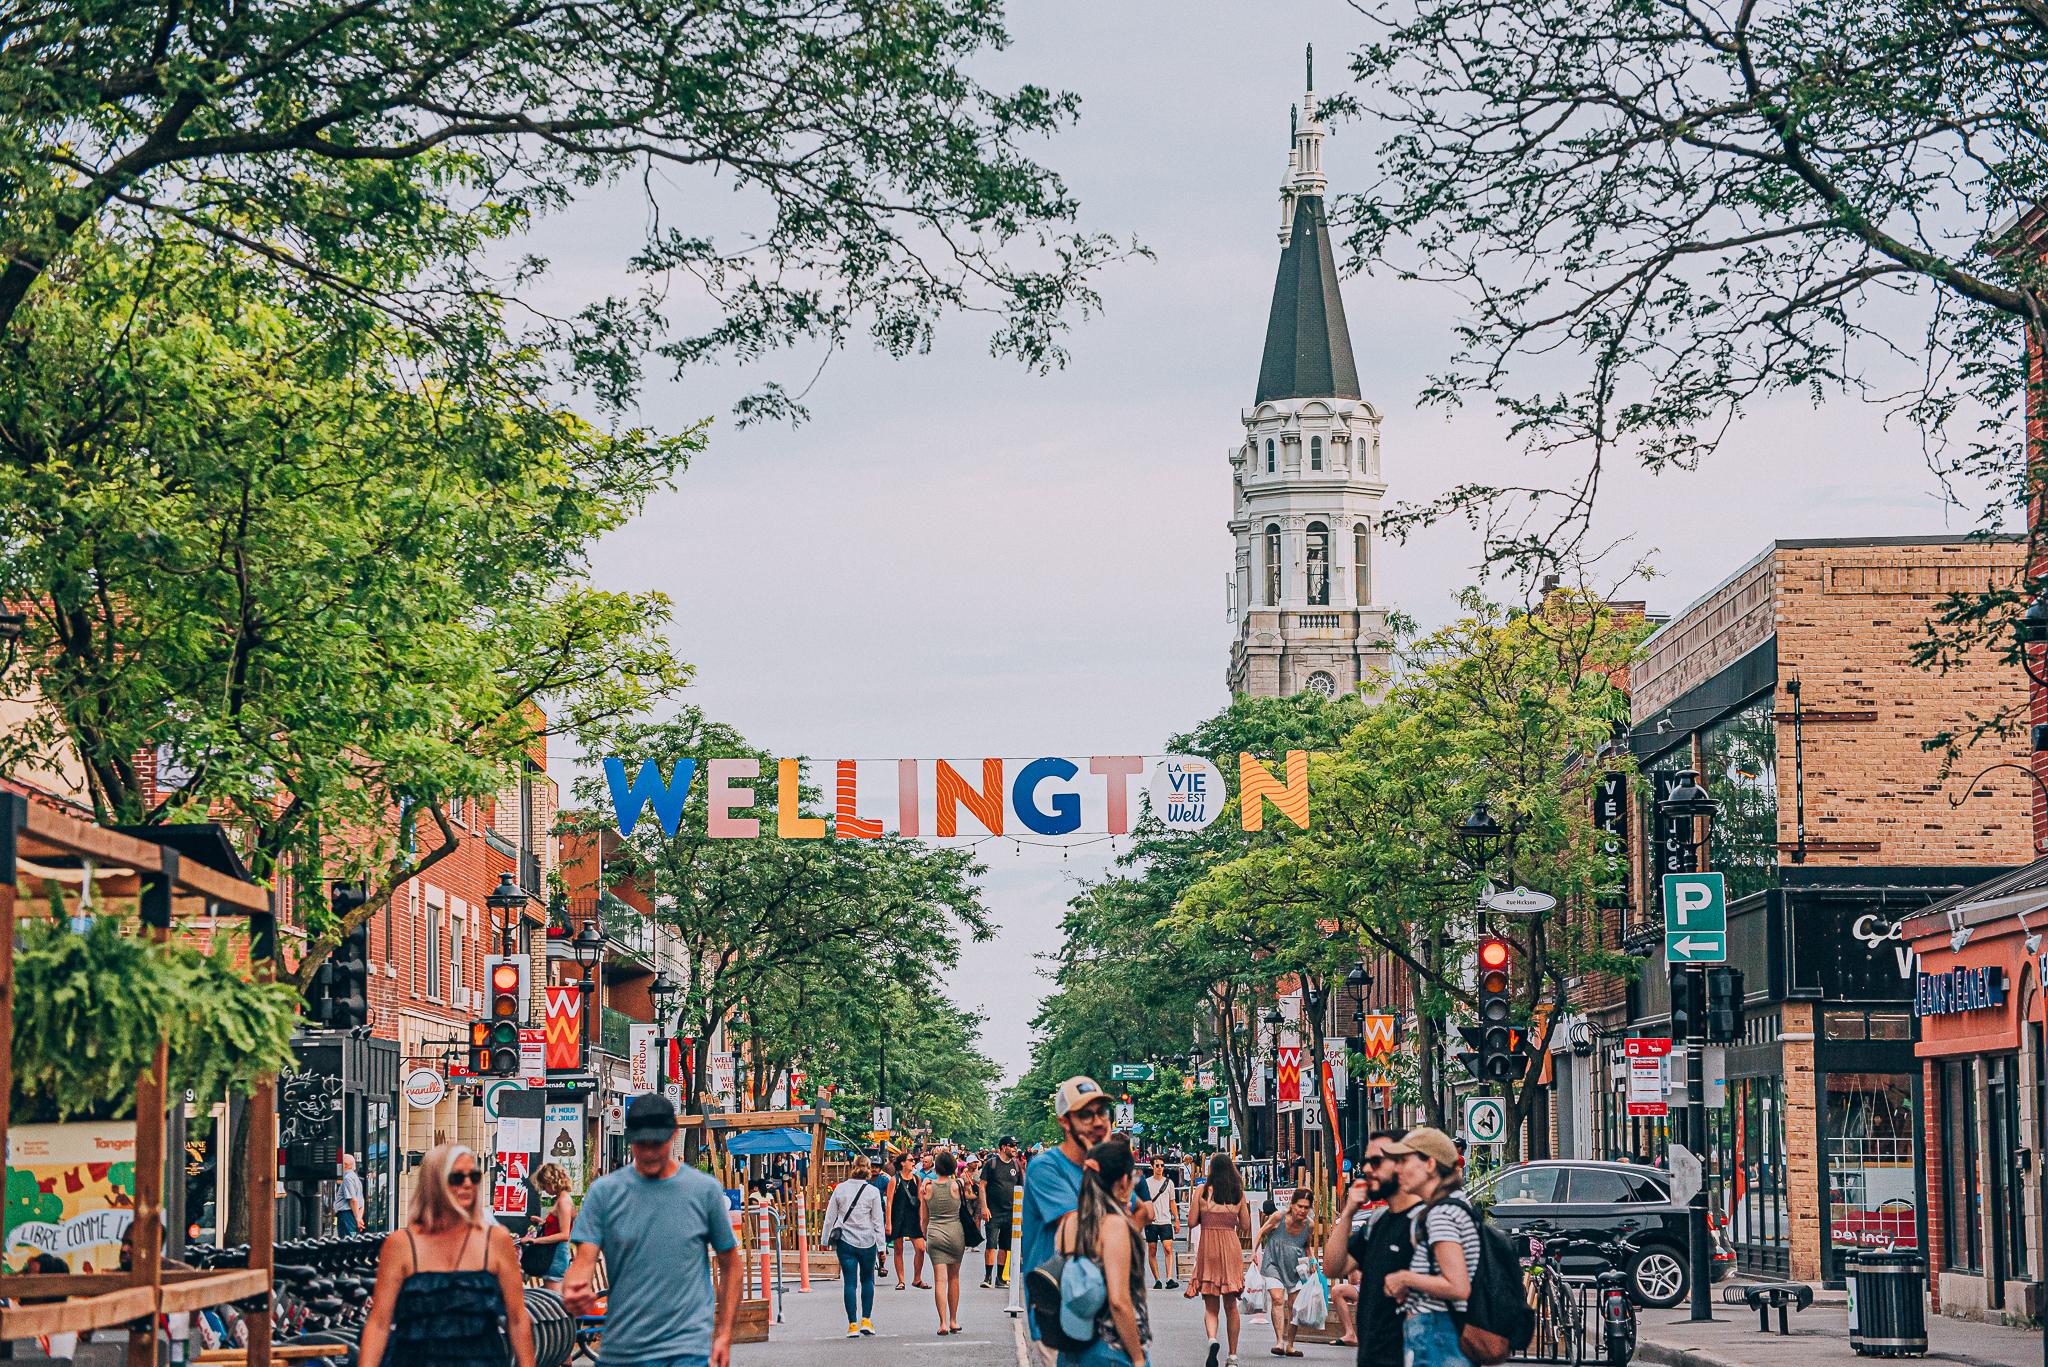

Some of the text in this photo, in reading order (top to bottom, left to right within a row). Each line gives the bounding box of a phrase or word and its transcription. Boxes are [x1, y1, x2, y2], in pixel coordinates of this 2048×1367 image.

[1167, 763, 1182, 773] LA
[1168, 773, 1207, 793] VIE
[1187, 793, 1207, 803] EST
[1167, 803, 1207, 823] Well
[1675, 882, 1713, 926] P
[1913, 971, 1950, 1018] JEANS
[1948, 966, 1993, 1014] JEANEX
[632, 1054, 640, 1074] MON
[639, 1039, 647, 1076] VERDUN
[632, 1075, 646, 1083] MA
[1112, 1064, 1123, 1079] P
[633, 1082, 656, 1090] WELL
[1213, 1100, 1224, 1115] P
[21, 1224, 61, 1251] LIBRE
[66, 1212, 110, 1248] COMME
